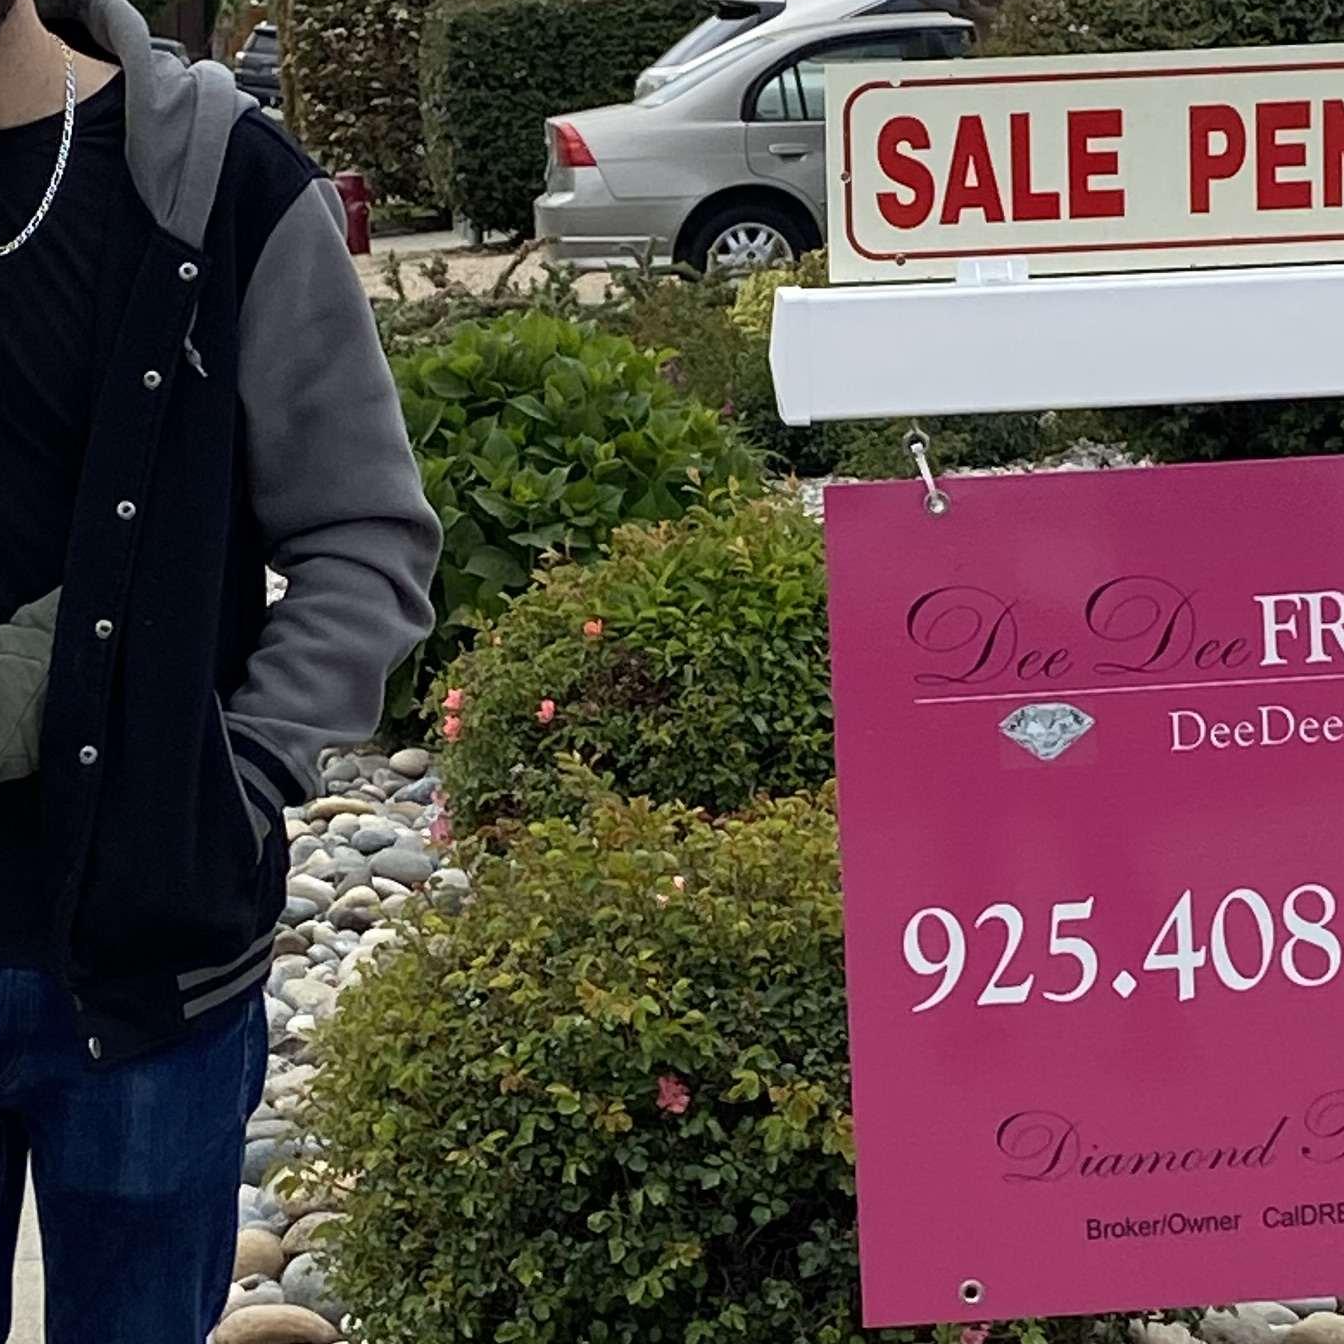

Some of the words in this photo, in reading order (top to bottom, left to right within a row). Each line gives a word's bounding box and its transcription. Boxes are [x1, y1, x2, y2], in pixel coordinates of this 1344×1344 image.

[876, 112, 1125, 230] SALE
[906, 585, 1072, 686] Dee
[1084, 575, 1253, 674] Dee
[996, 1109, 1290, 1182] Diamond
[1086, 1212, 1242, 1241] Broker/Owner
